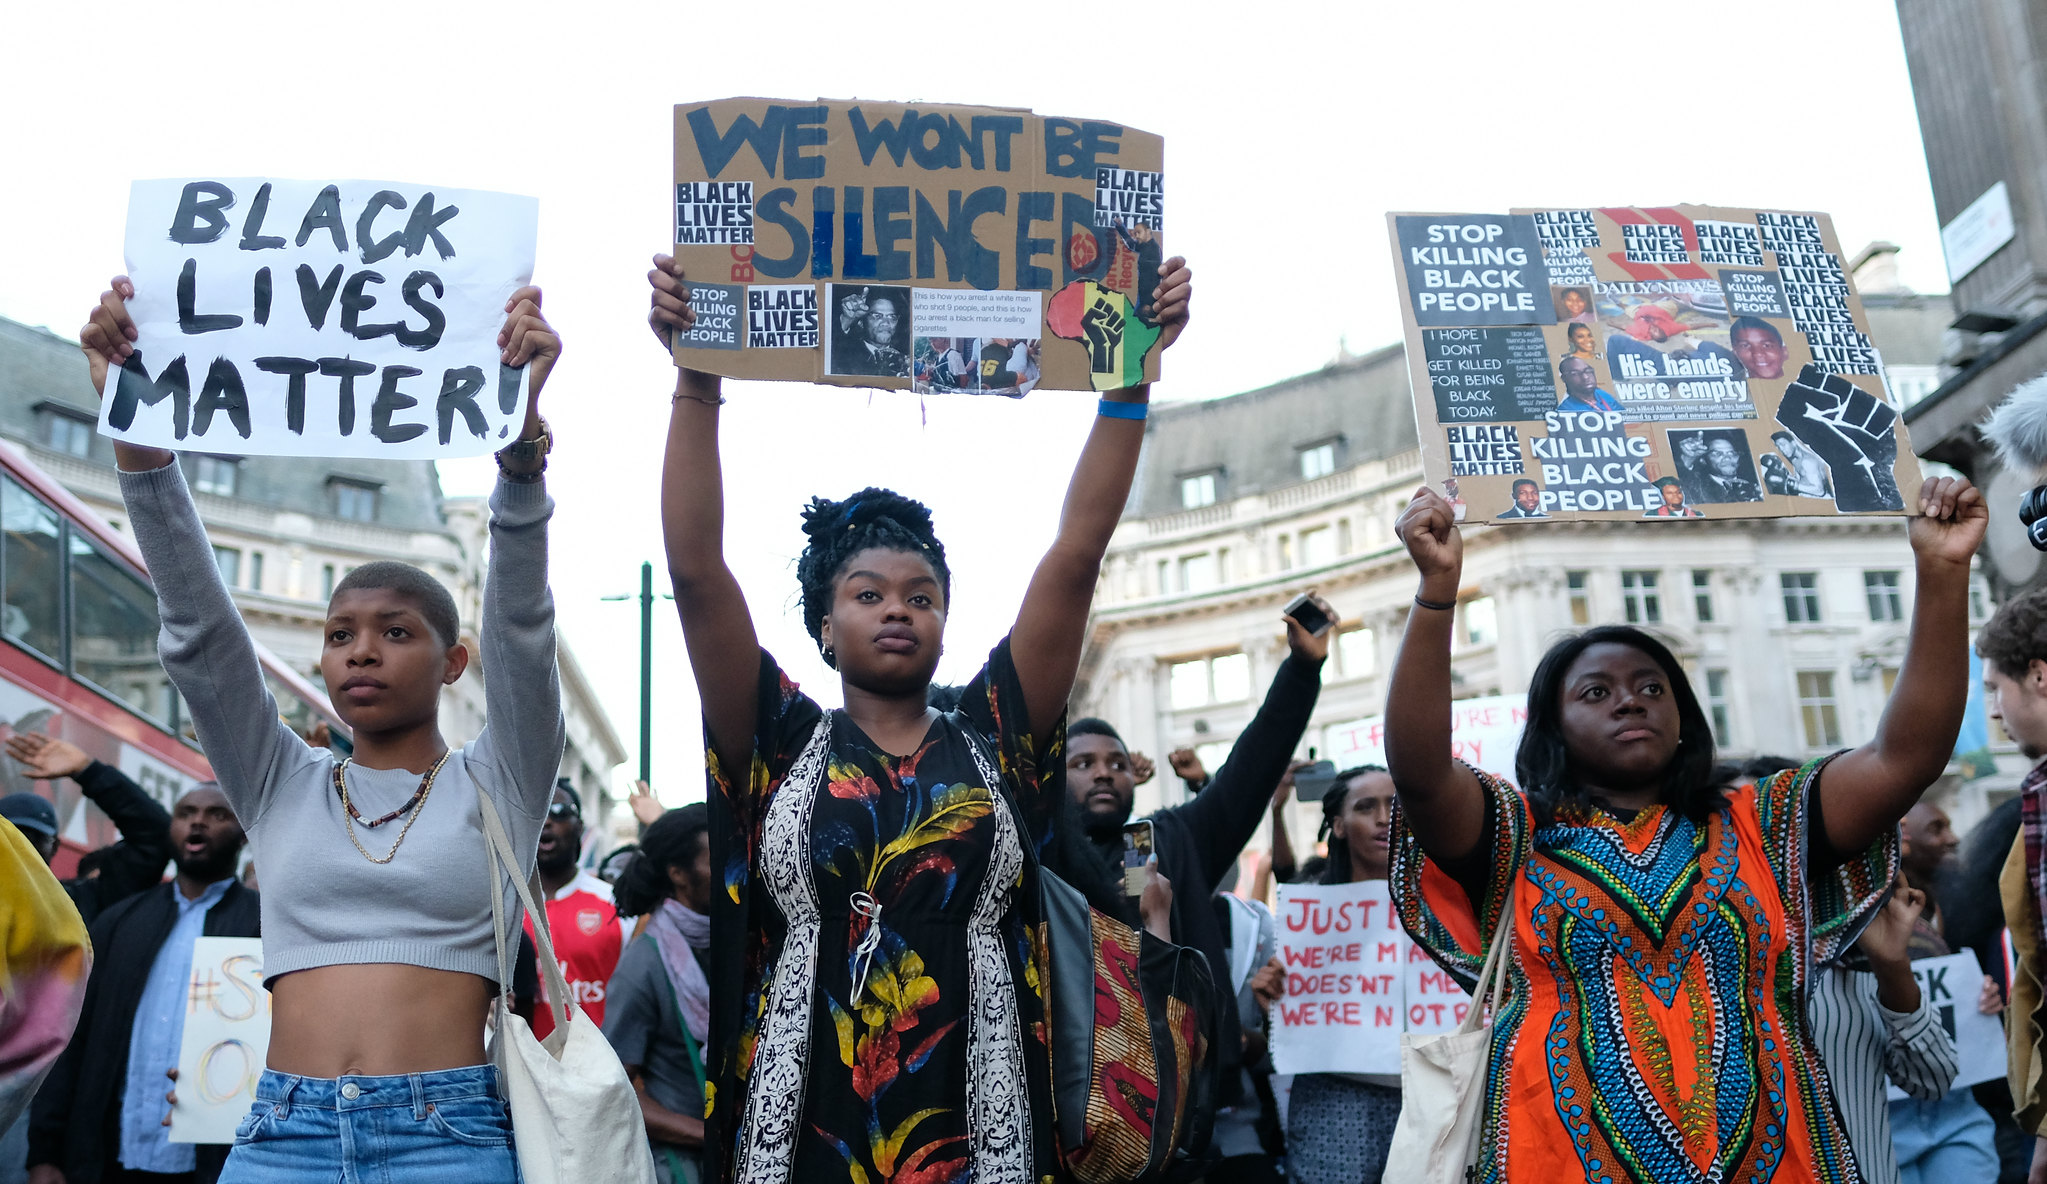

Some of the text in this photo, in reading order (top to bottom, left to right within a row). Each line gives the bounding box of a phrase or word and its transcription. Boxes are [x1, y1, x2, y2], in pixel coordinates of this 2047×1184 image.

[686, 105, 1123, 180] WE WONT BE
[1096, 168, 1163, 193] BLACK
[677, 182, 751, 203] BLACK
[1096, 189, 1163, 215] LIVES
[169, 181, 460, 264] BLACK
[677, 204, 753, 226] LIVES
[1534, 211, 1594, 224] BLACK
[1755, 213, 1817, 229] BLACK
[677, 227, 754, 243] MATTER
[751, 186, 1117, 291] SILENCED
[1427, 224, 1503, 243] STOP
[1537, 224, 1598, 238] LIVES
[1622, 224, 1683, 238] BLACK
[1694, 224, 1758, 240] BLACK
[1760, 226, 1822, 243] LIVES
[1540, 238, 1601, 248] MATTER
[1624, 237, 1687, 251] LIVES
[1698, 238, 1762, 255] LIVES
[1763, 241, 1825, 254] MATTER
[1411, 246, 1528, 266] KILLING
[1549, 248, 1582, 257] STOP
[1627, 251, 1689, 263] MATTER
[1700, 252, 1764, 266] MATTER
[1544, 257, 1593, 266] KILLING
[1776, 252, 1841, 269] BLACK
[1549, 266, 1592, 276] BLACK
[1732, 273, 1765, 284] STOP
[1780, 267, 1846, 284] LIVES
[1424, 269, 1524, 289] BLACK
[1548, 275, 1598, 285] PEOPLE
[1594, 279, 1721, 294] DAILY NEWS
[692, 288, 728, 301] STOP
[1727, 282, 1777, 294] KILLING
[1784, 283, 1851, 296] MATTER
[177, 258, 446, 351] LIVES
[748, 290, 817, 311] BLACK
[914, 292, 928, 300] This
[937, 292, 952, 300] how
[968, 293, 988, 301] arrest
[995, 294, 1014, 302] white
[1418, 292, 1536, 312] PEOPLE
[1734, 293, 1776, 304] BLACK
[1788, 294, 1848, 309] BLACK
[686, 301, 737, 316] ILLING
[1017, 305, 1032, 313] how
[1734, 302, 1782, 313] PEOPLE
[691, 316, 732, 329] LACK
[750, 310, 818, 332] LIVES
[914, 314, 926, 322] you
[956, 314, 974, 322] black
[1004, 315, 1025, 325] selling
[1792, 308, 1853, 324] LIVES
[1431, 329, 1488, 340] I HOPE I
[1796, 323, 1857, 333] MATTER
[681, 329, 735, 343] PEOPLE
[751, 332, 819, 347] MATTER
[1806, 331, 1873, 348] BLACK
[1441, 344, 1482, 356] DON'T
[1810, 347, 1875, 363] LIVES
[1428, 360, 1453, 371] GET
[1459, 359, 1502, 371] KILLED
[1618, 352, 1733, 377] His hands
[1814, 361, 1879, 375] MATTER
[1431, 374, 1505, 387] FOR BEING
[108, 349, 526, 446] MATTER!
[1450, 390, 1492, 401] BLACK
[1615, 378, 1747, 402] were empty
[1449, 406, 1497, 418] TODAY.
[1546, 411, 1624, 433] STOP
[1447, 425, 1519, 443] BLACK
[1450, 443, 1522, 462] LIVES
[1530, 436, 1652, 458] KILLING
[1452, 461, 1525, 475] MATTER
[1542, 462, 1650, 485] BLACK
[1539, 489, 1663, 511] PEOPLE
[1286, 898, 1379, 935] JUST
[1284, 942, 1362, 968] WE'RE
[1281, 1001, 1361, 1027] WE'RE
